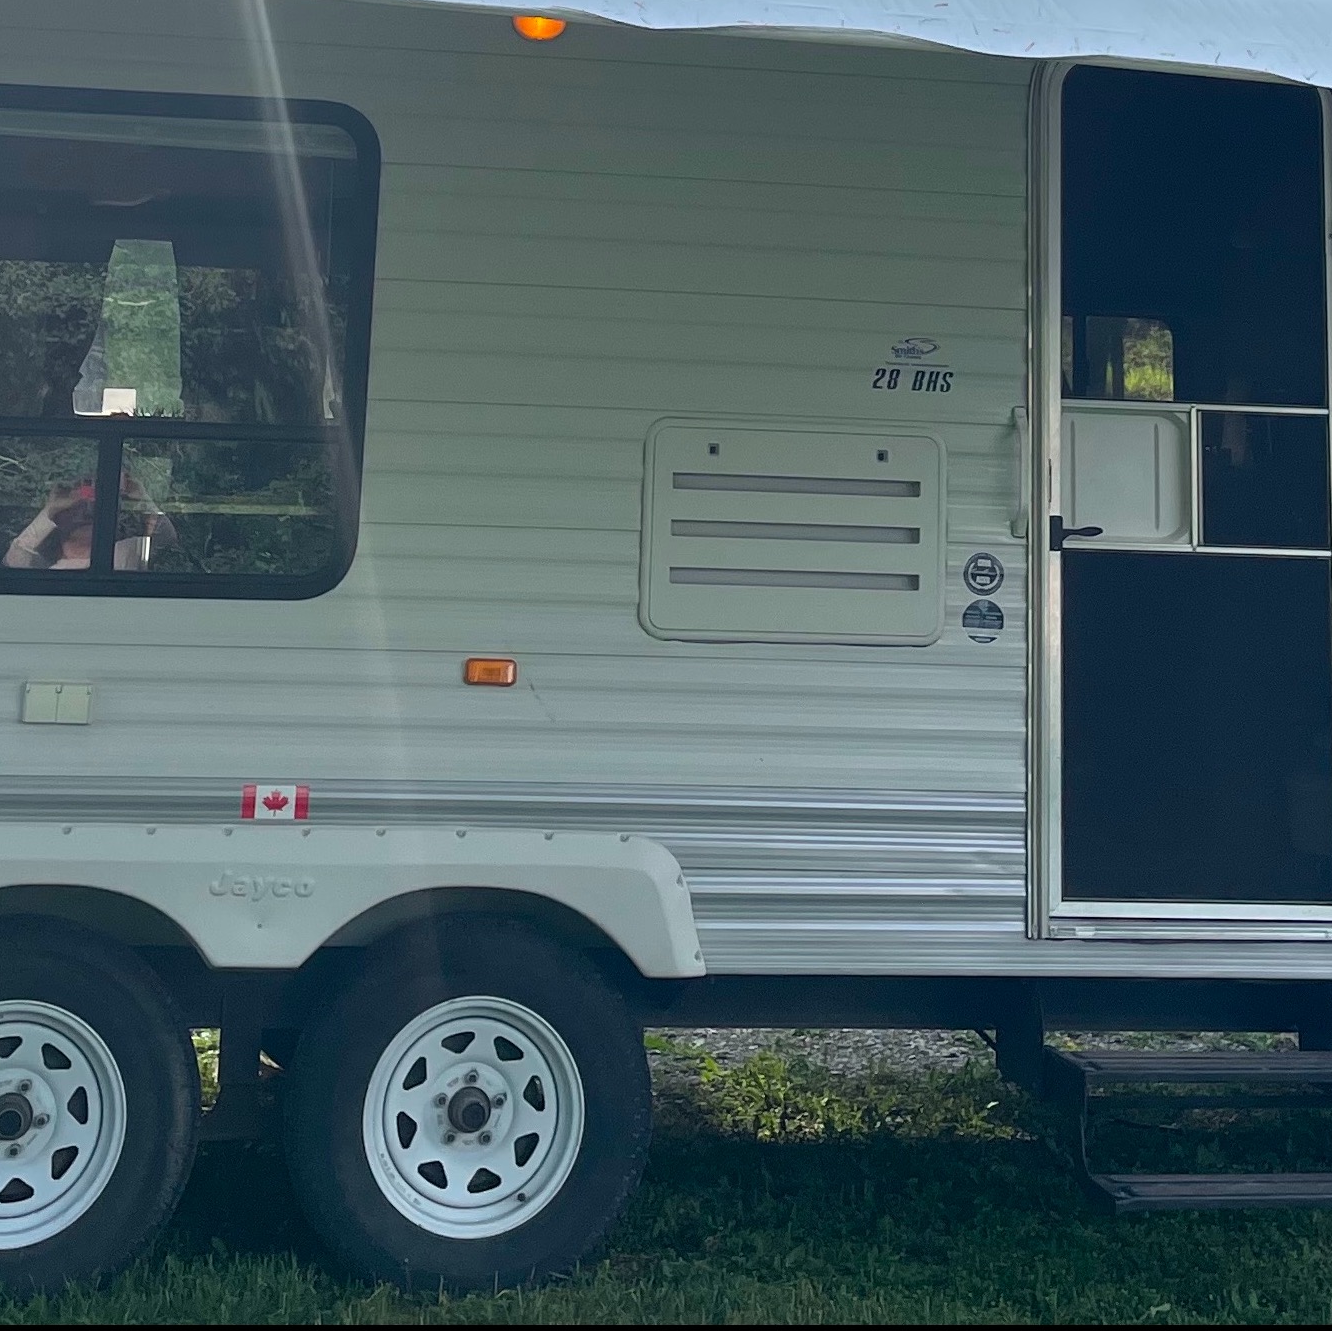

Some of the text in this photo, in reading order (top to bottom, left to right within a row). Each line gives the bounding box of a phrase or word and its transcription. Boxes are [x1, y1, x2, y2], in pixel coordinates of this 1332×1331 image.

[872, 368, 954, 392] 28 BHS
[209, 869, 315, 902] Jayco
